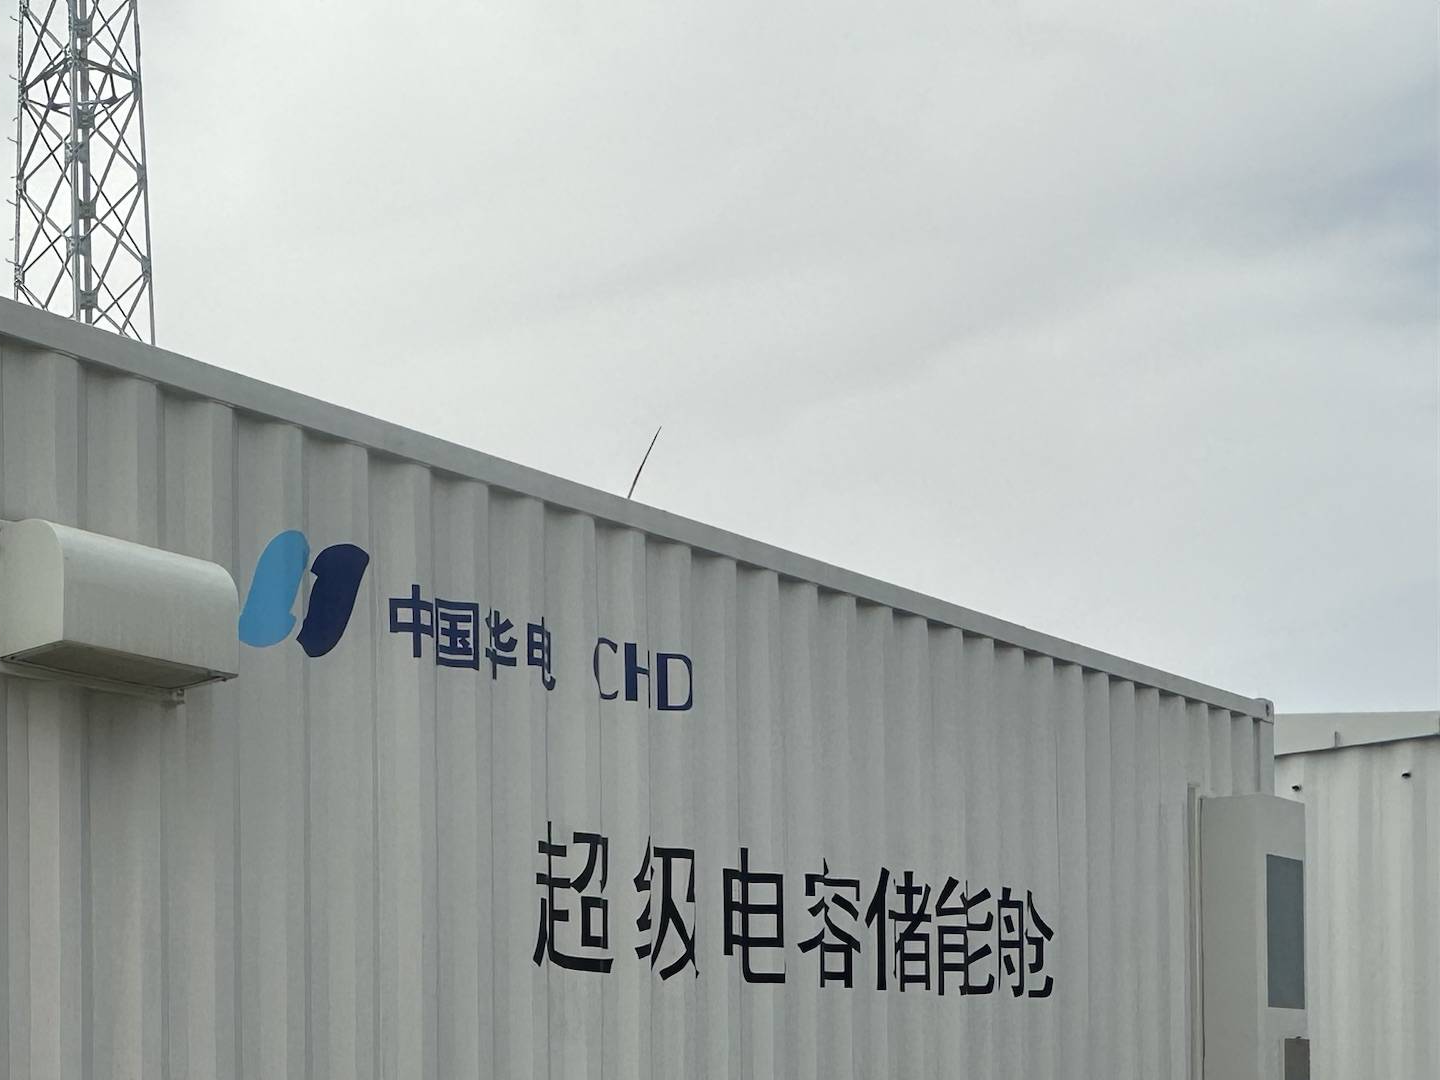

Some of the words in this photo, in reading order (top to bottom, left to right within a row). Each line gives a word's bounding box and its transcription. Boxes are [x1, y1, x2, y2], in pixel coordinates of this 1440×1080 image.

[388, 583, 556, 691] 中国华电
[593, 636, 694, 712] CHD
[532, 820, 1055, 999] 超级电容储能舱
